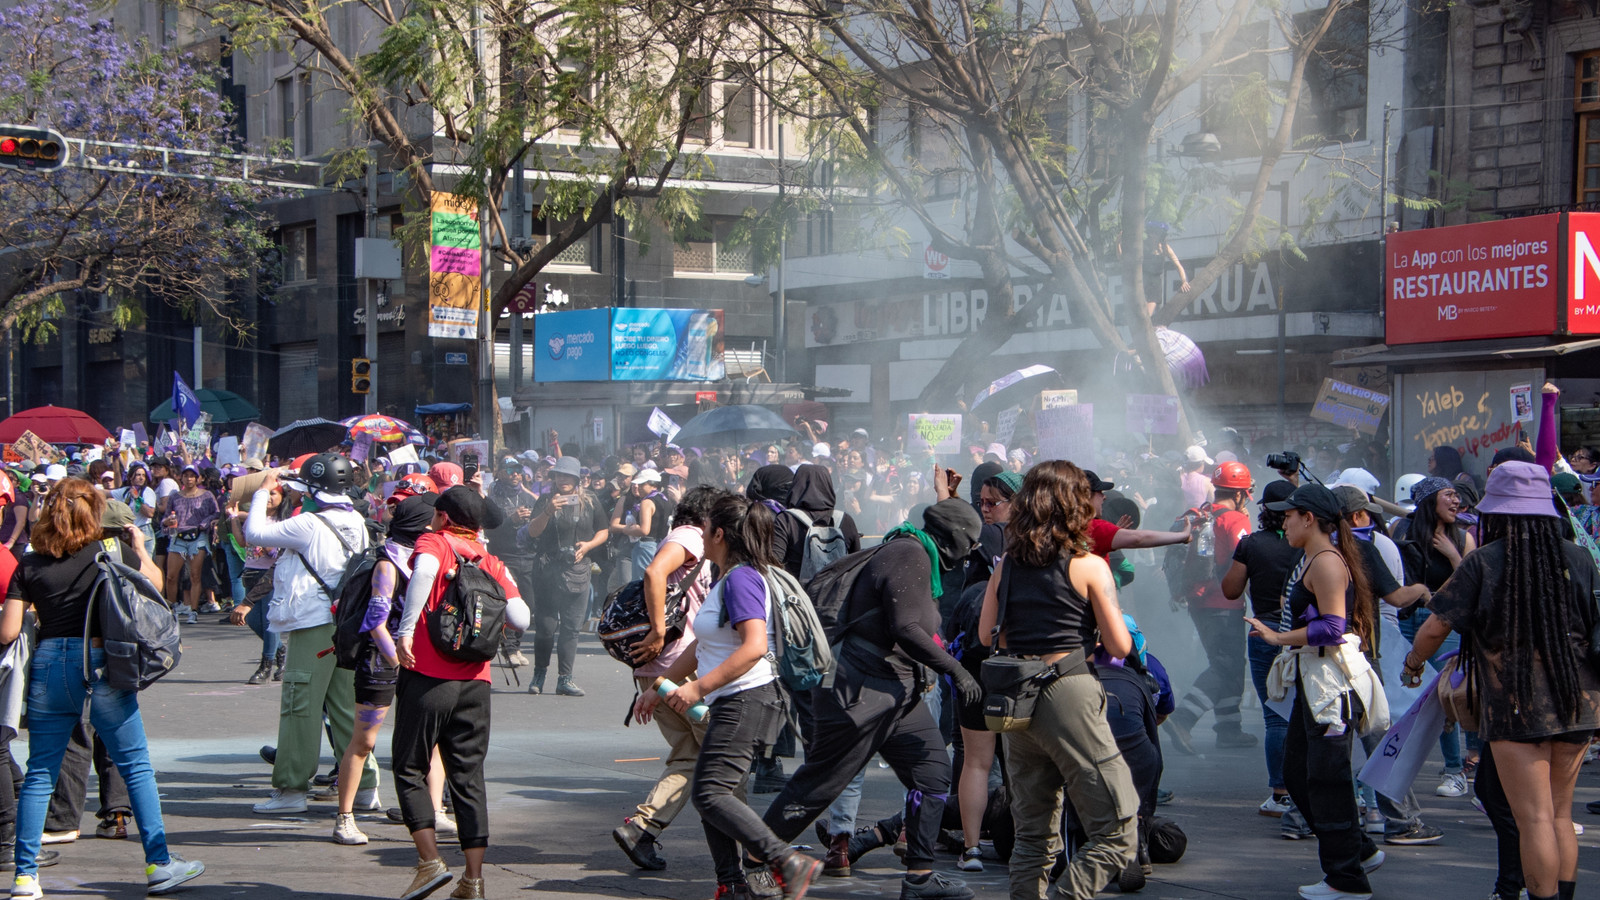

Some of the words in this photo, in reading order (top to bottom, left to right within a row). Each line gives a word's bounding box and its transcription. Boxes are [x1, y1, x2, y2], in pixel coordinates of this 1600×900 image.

[926, 250, 948, 266] WC
[1393, 252, 1408, 269] La
[1411, 250, 1437, 270] App
[1440, 249, 1464, 264] con
[1467, 244, 1488, 261] los
[1491, 239, 1548, 261] mejores
[1393, 264, 1548, 300] RESTAURANTES
[923, 283, 1073, 336] LIBRRIA
[1437, 304, 1458, 320] MB
[1574, 308, 1585, 316] BY
[566, 331, 595, 344] mercado
[566, 346, 583, 360] pago
[1331, 382, 1371, 399] MARCHO
[1366, 404, 1380, 415] NO
[1416, 385, 1464, 418] Yaleb
[920, 430, 935, 441] NO
